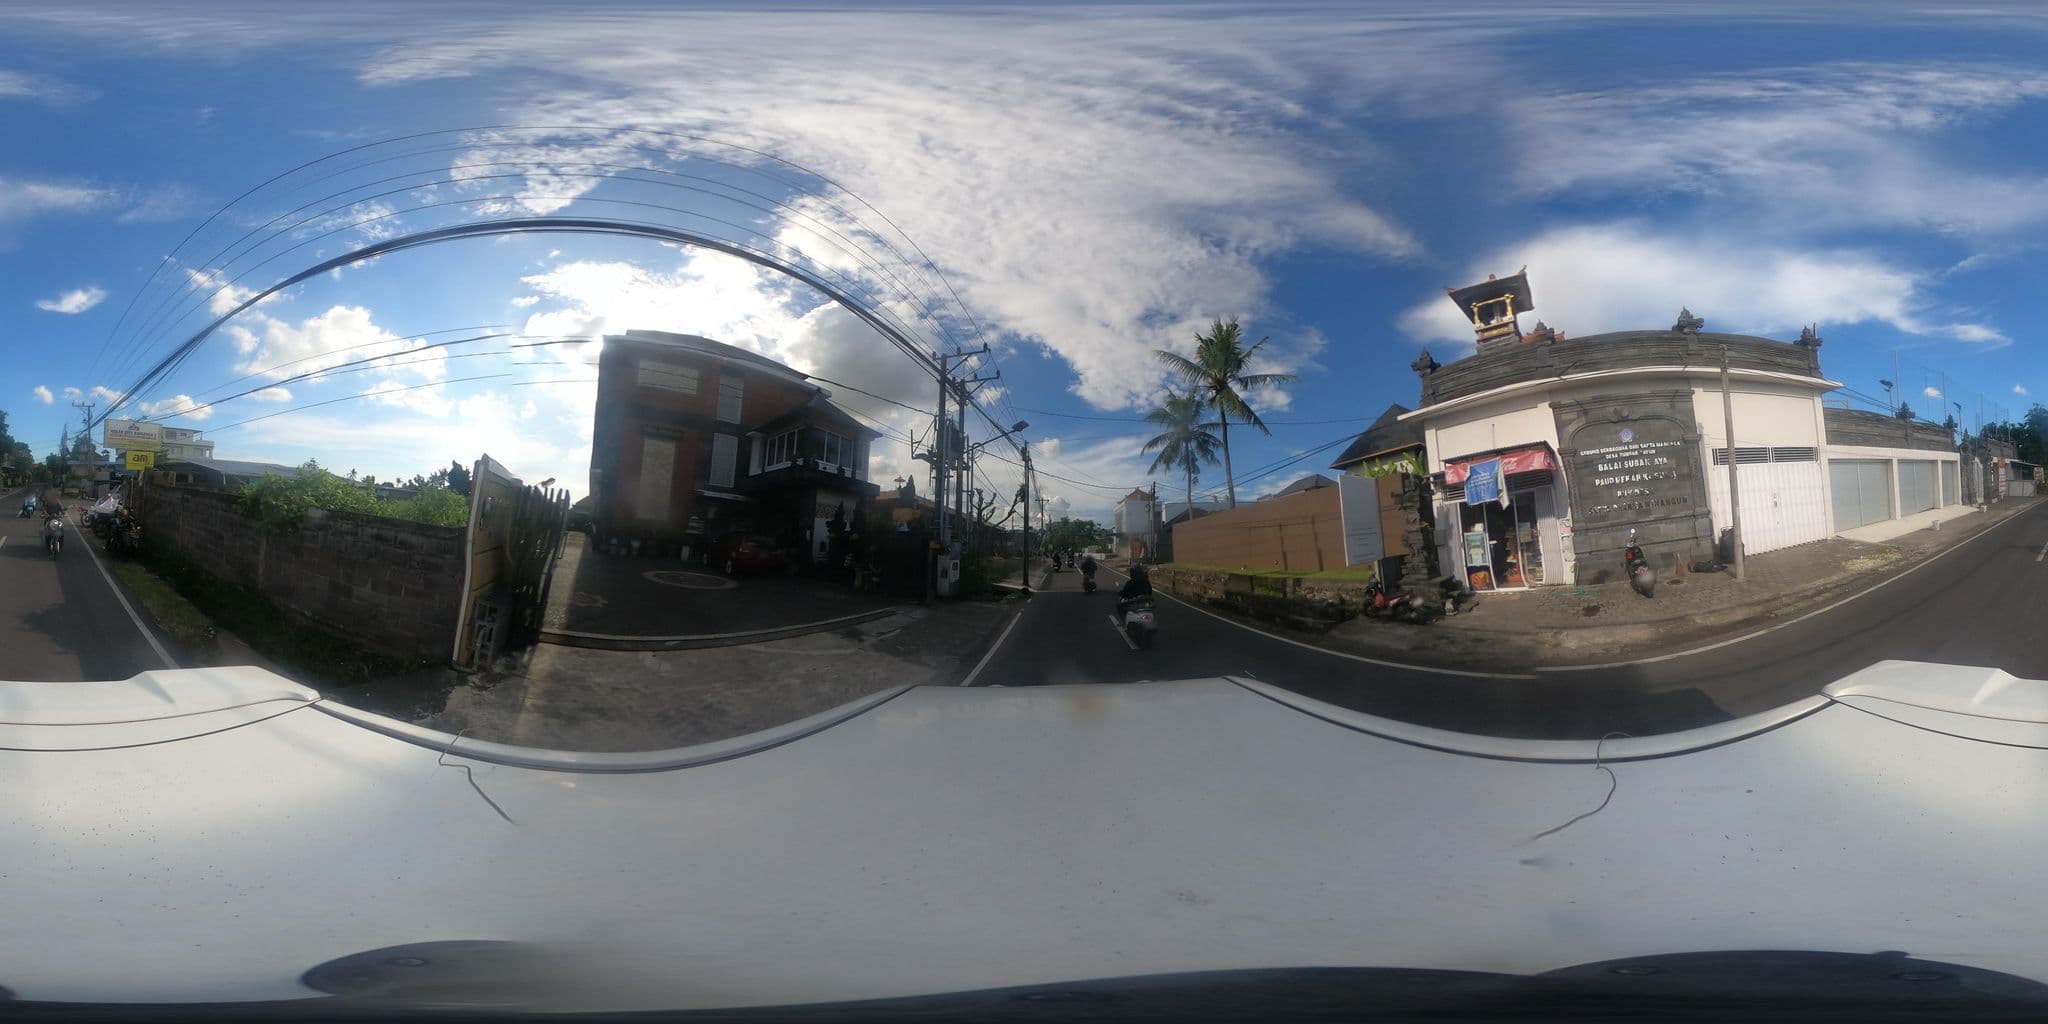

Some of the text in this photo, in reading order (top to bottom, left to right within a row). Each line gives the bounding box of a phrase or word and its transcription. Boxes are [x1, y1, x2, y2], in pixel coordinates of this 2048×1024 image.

[1598, 462, 1622, 472] BALAI
[1624, 458, 1651, 469] SUBAK
[1595, 477, 1614, 486] PAUD
